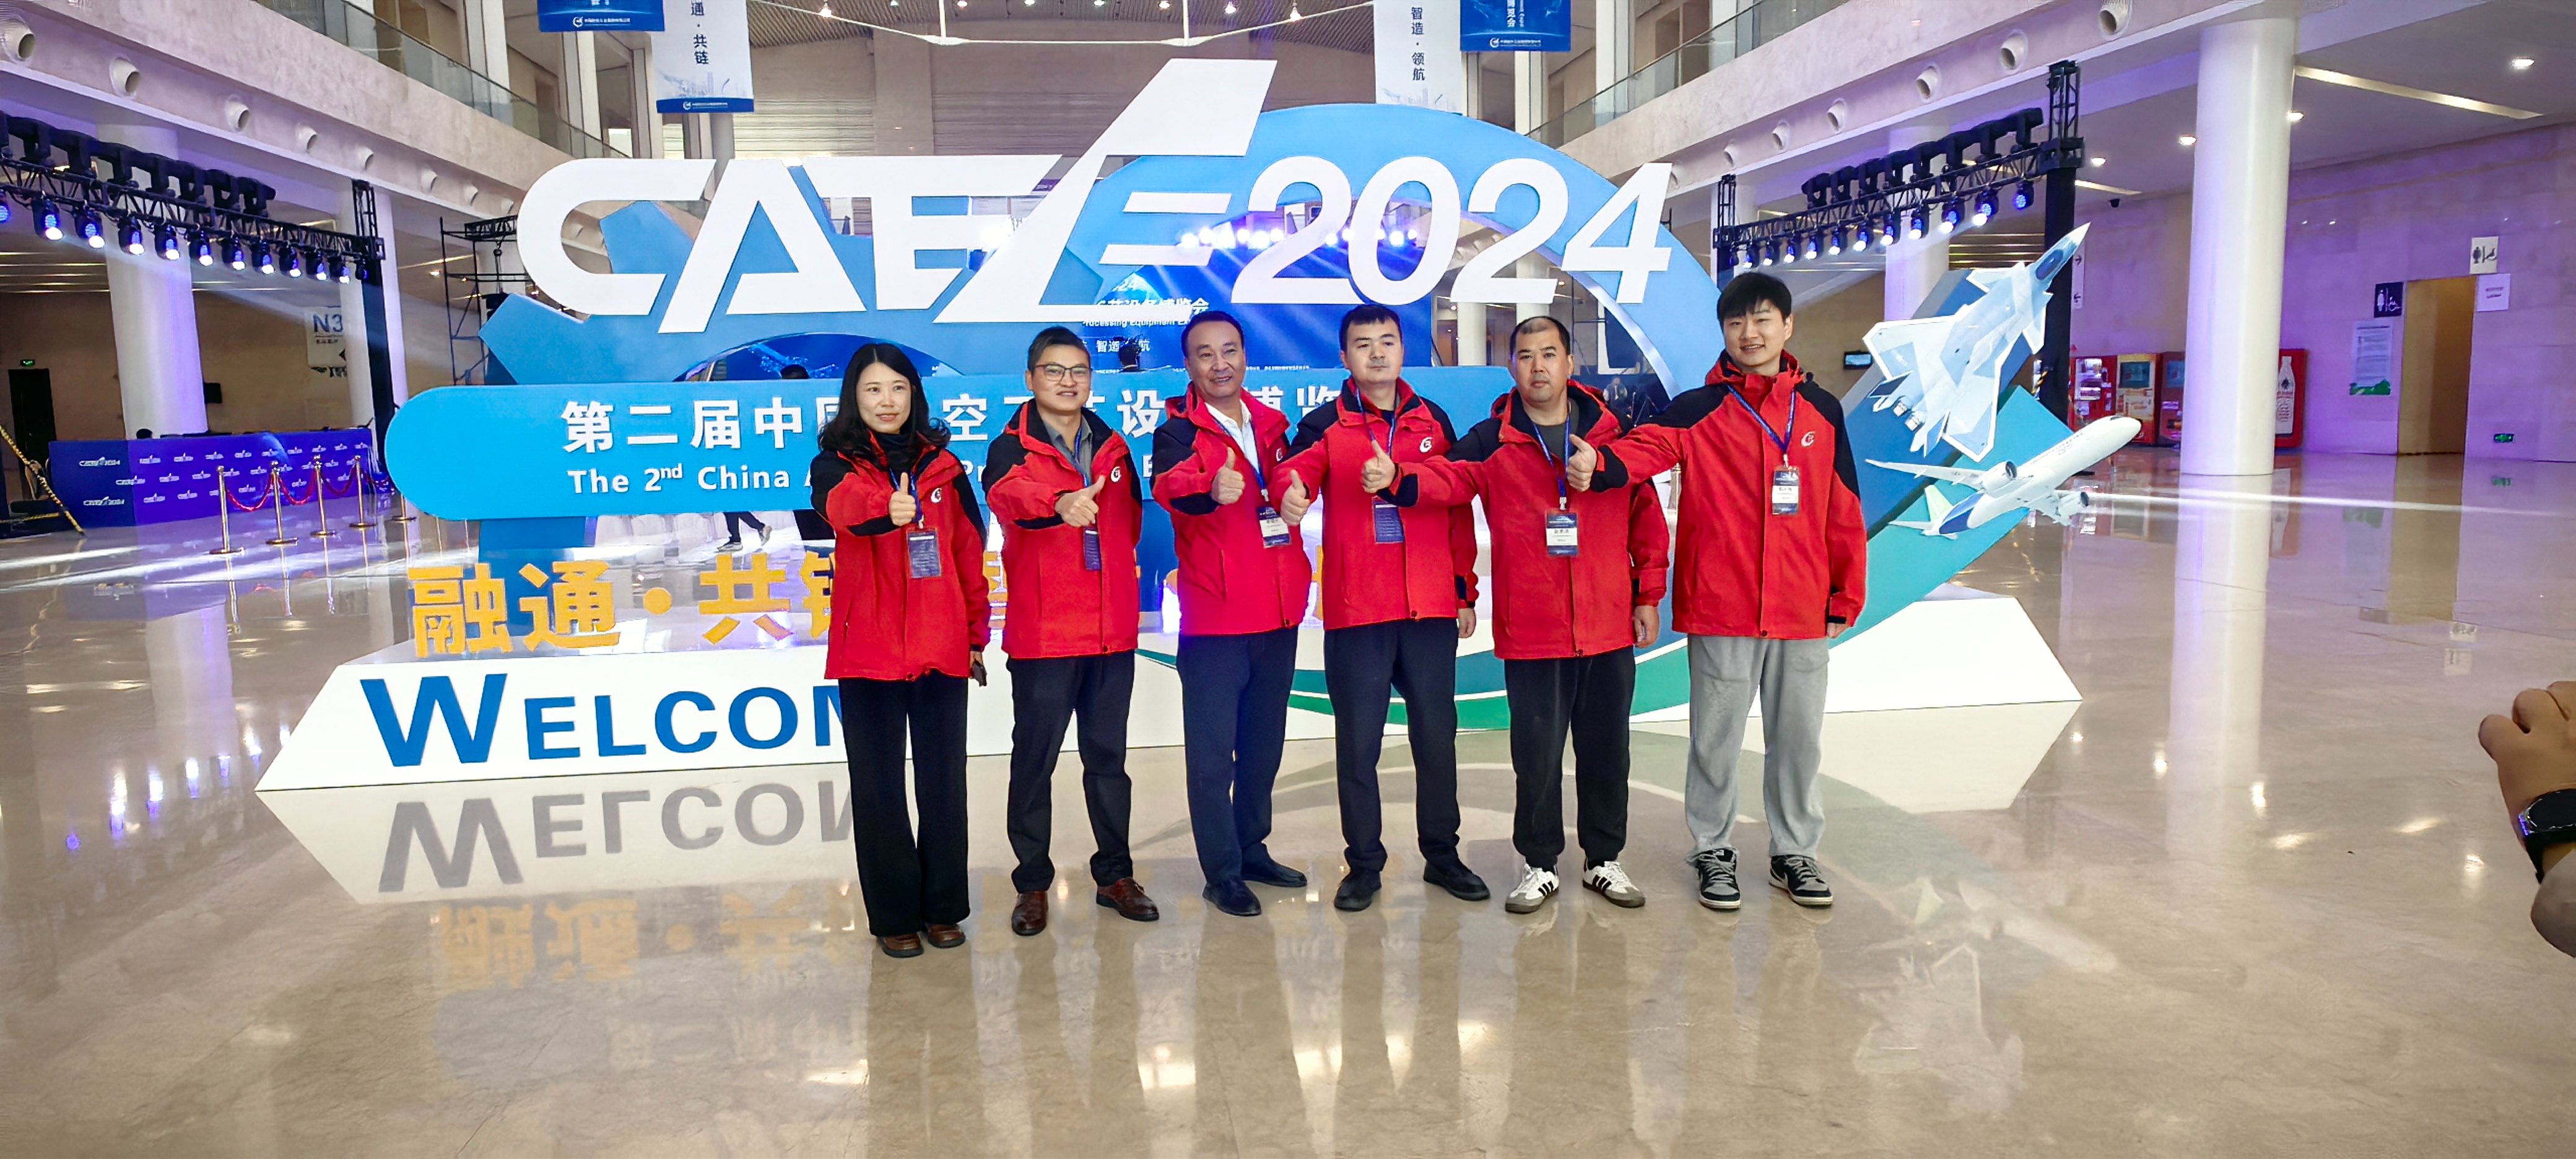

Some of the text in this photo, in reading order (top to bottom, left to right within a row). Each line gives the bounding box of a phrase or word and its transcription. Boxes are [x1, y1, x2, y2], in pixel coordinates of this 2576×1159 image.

[690, 0, 709, 65] 通·共链
[1411, 6, 1425, 81] 智造·领航
[567, 468, 629, 493] The
[697, 464, 790, 491] China
